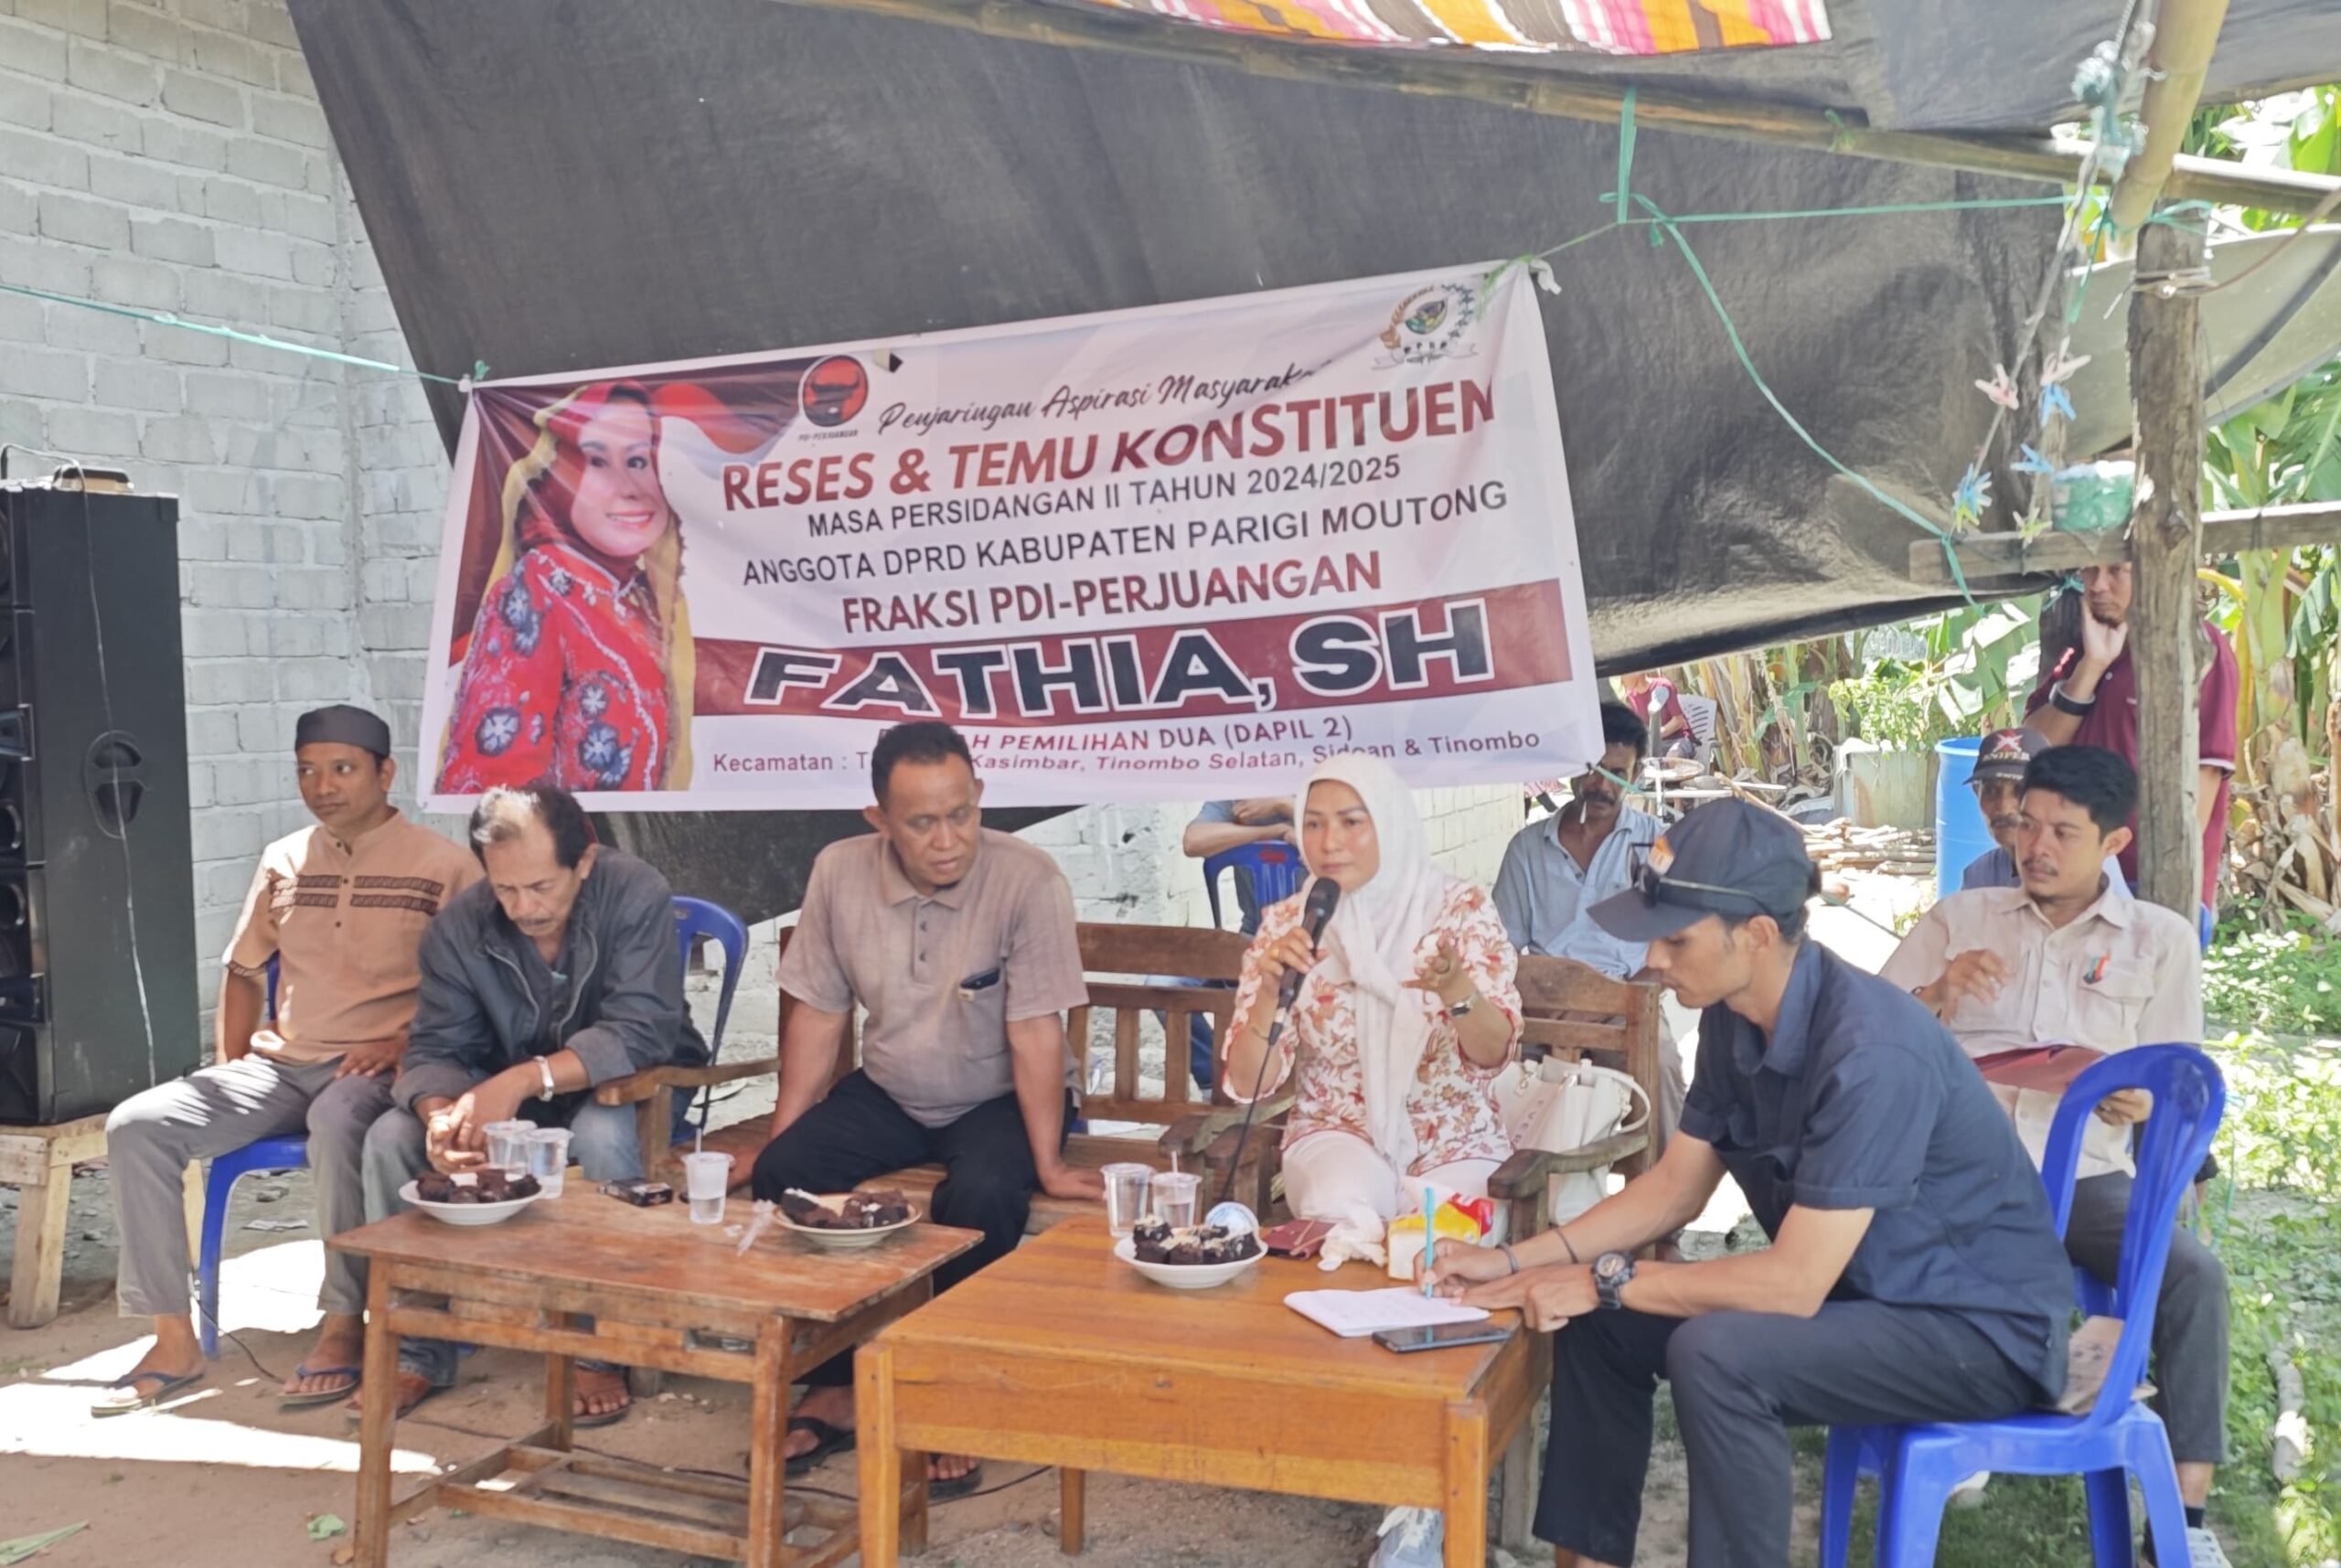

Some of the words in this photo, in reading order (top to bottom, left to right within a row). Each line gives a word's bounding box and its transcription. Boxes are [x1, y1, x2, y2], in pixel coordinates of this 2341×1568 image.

[723, 453, 876, 511] RESES
[890, 448, 931, 495] &
[948, 434, 1099, 489] TEMU
[1110, 379, 1495, 474] KONSTITUEN
[877, 401, 1035, 436] Penjaringan
[1042, 382, 1153, 421] Aspirasi
[743, 551, 876, 586] ANGGOTA
[883, 544, 966, 577] DPRD
[977, 523, 1175, 569] KABUPATEN
[1188, 510, 1309, 549] PARIGI
[1321, 480, 1507, 534] MOUTONG
[807, 507, 882, 538] MASA
[892, 486, 1095, 529] PERSIDANGAN
[1105, 483, 1120, 508] II
[1129, 474, 1236, 508] TAHUN
[1247, 454, 1401, 495] 2024/2025
[842, 588, 979, 634] FRAKSI
[990, 550, 1382, 624] PDI-PERJUANGAN
[1289, 597, 1495, 697] SH
[713, 753, 833, 772] Kecamatan
[1097, 753, 1200, 771] Tinombo
[1209, 750, 1304, 769] Selatan,
[1406, 738, 1422, 755] &
[1430, 730, 1540, 754] Tinombo
[999, 731, 1149, 751] PEMILIHAN
[1160, 727, 1215, 748] DUA
[1224, 719, 1315, 748] (DAPIL
[1323, 715, 1352, 741] 2)
